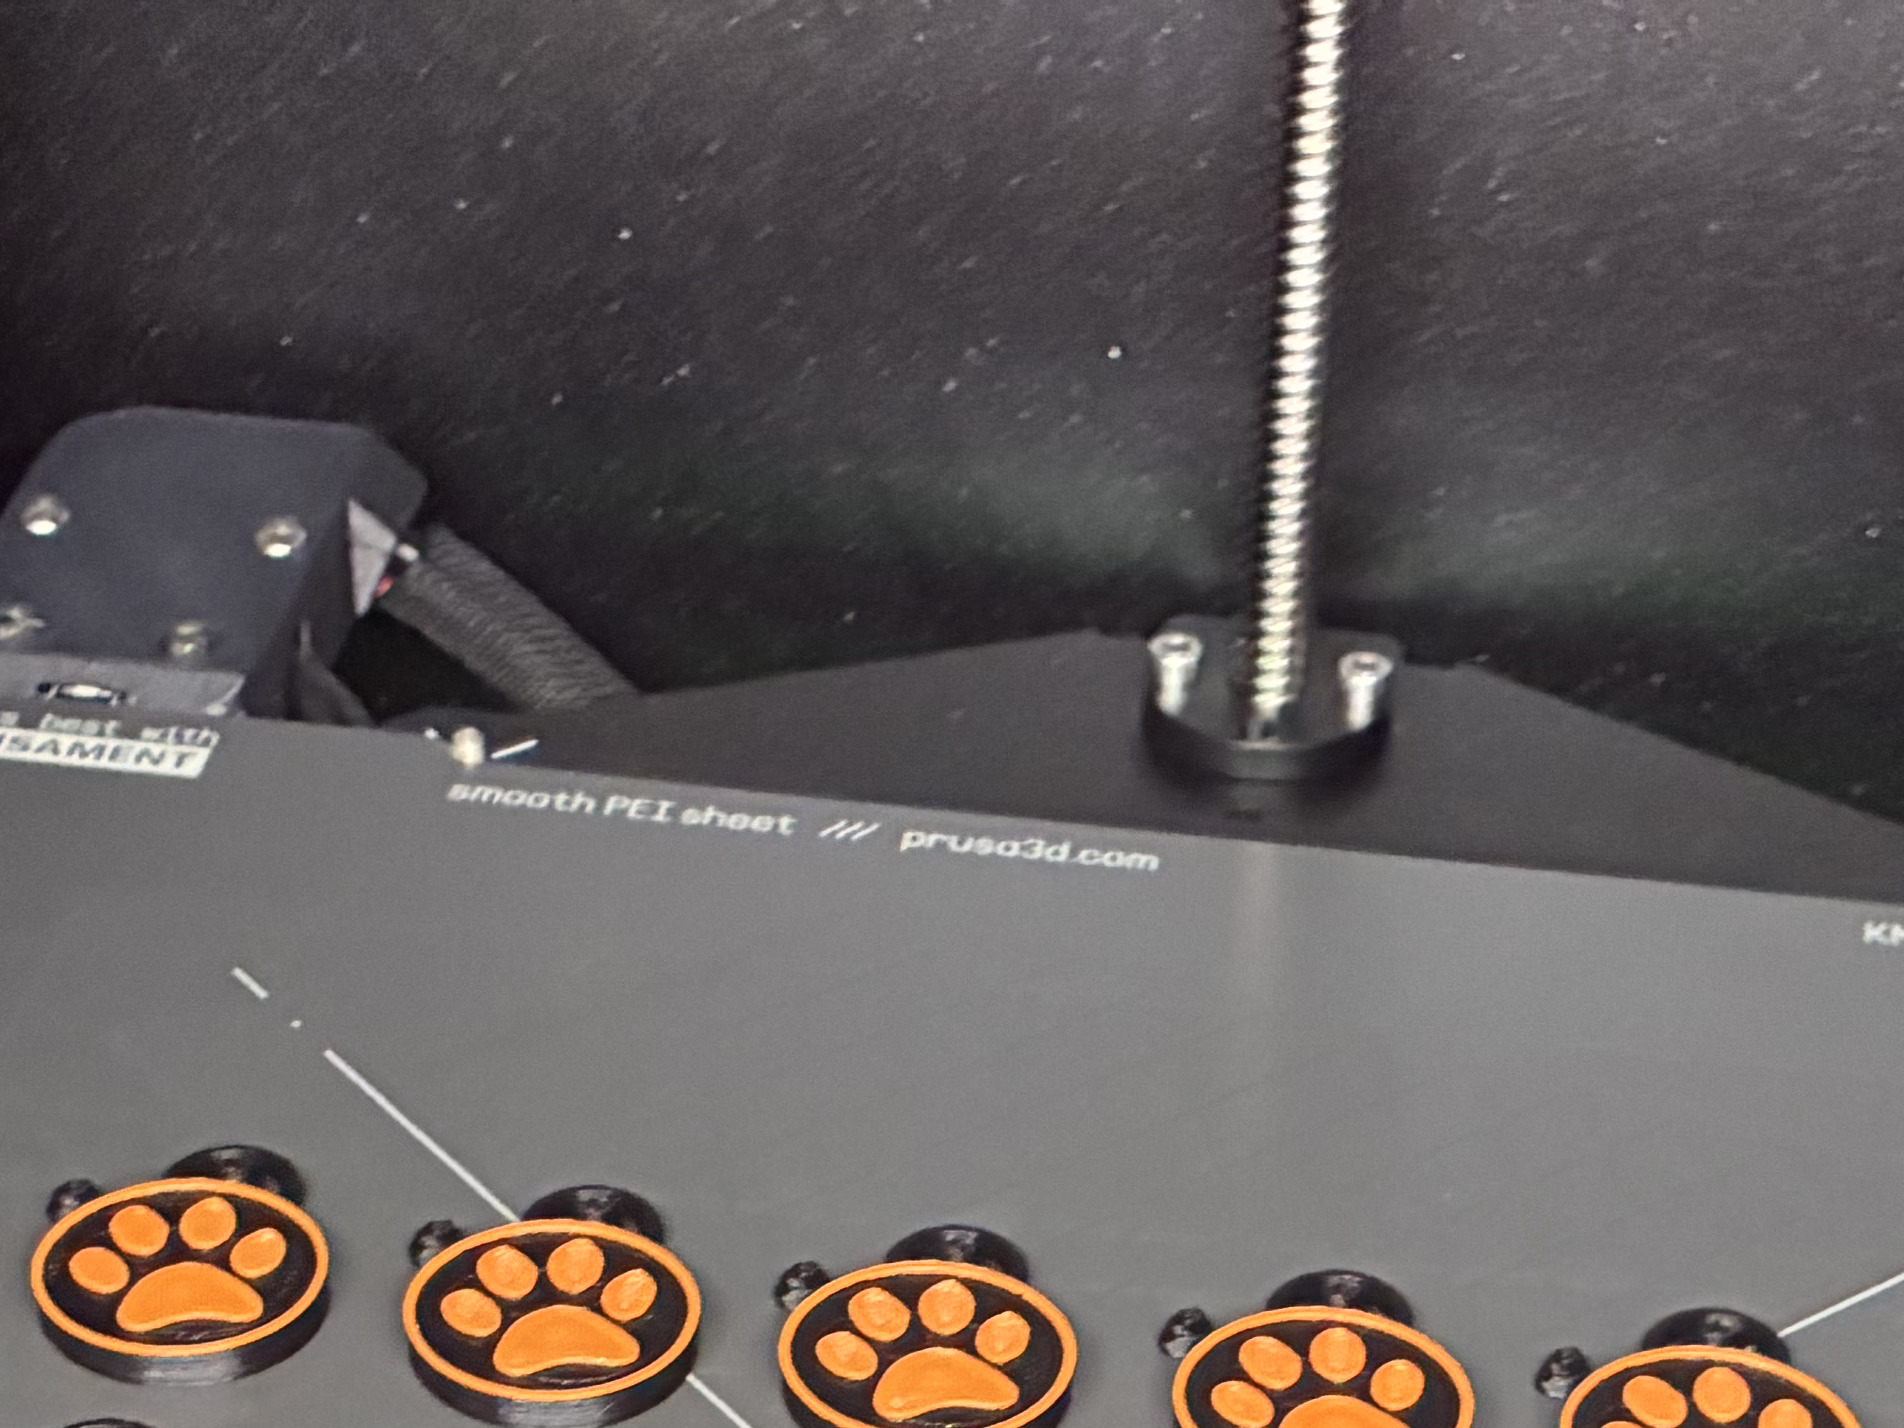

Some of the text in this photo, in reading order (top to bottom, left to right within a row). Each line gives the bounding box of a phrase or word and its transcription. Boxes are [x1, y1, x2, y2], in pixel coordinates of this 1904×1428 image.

[447, 783, 596, 815] smooth
[603, 794, 678, 823] PEI
[680, 805, 798, 836] sheet
[899, 830, 1161, 871] prusa3d.com
